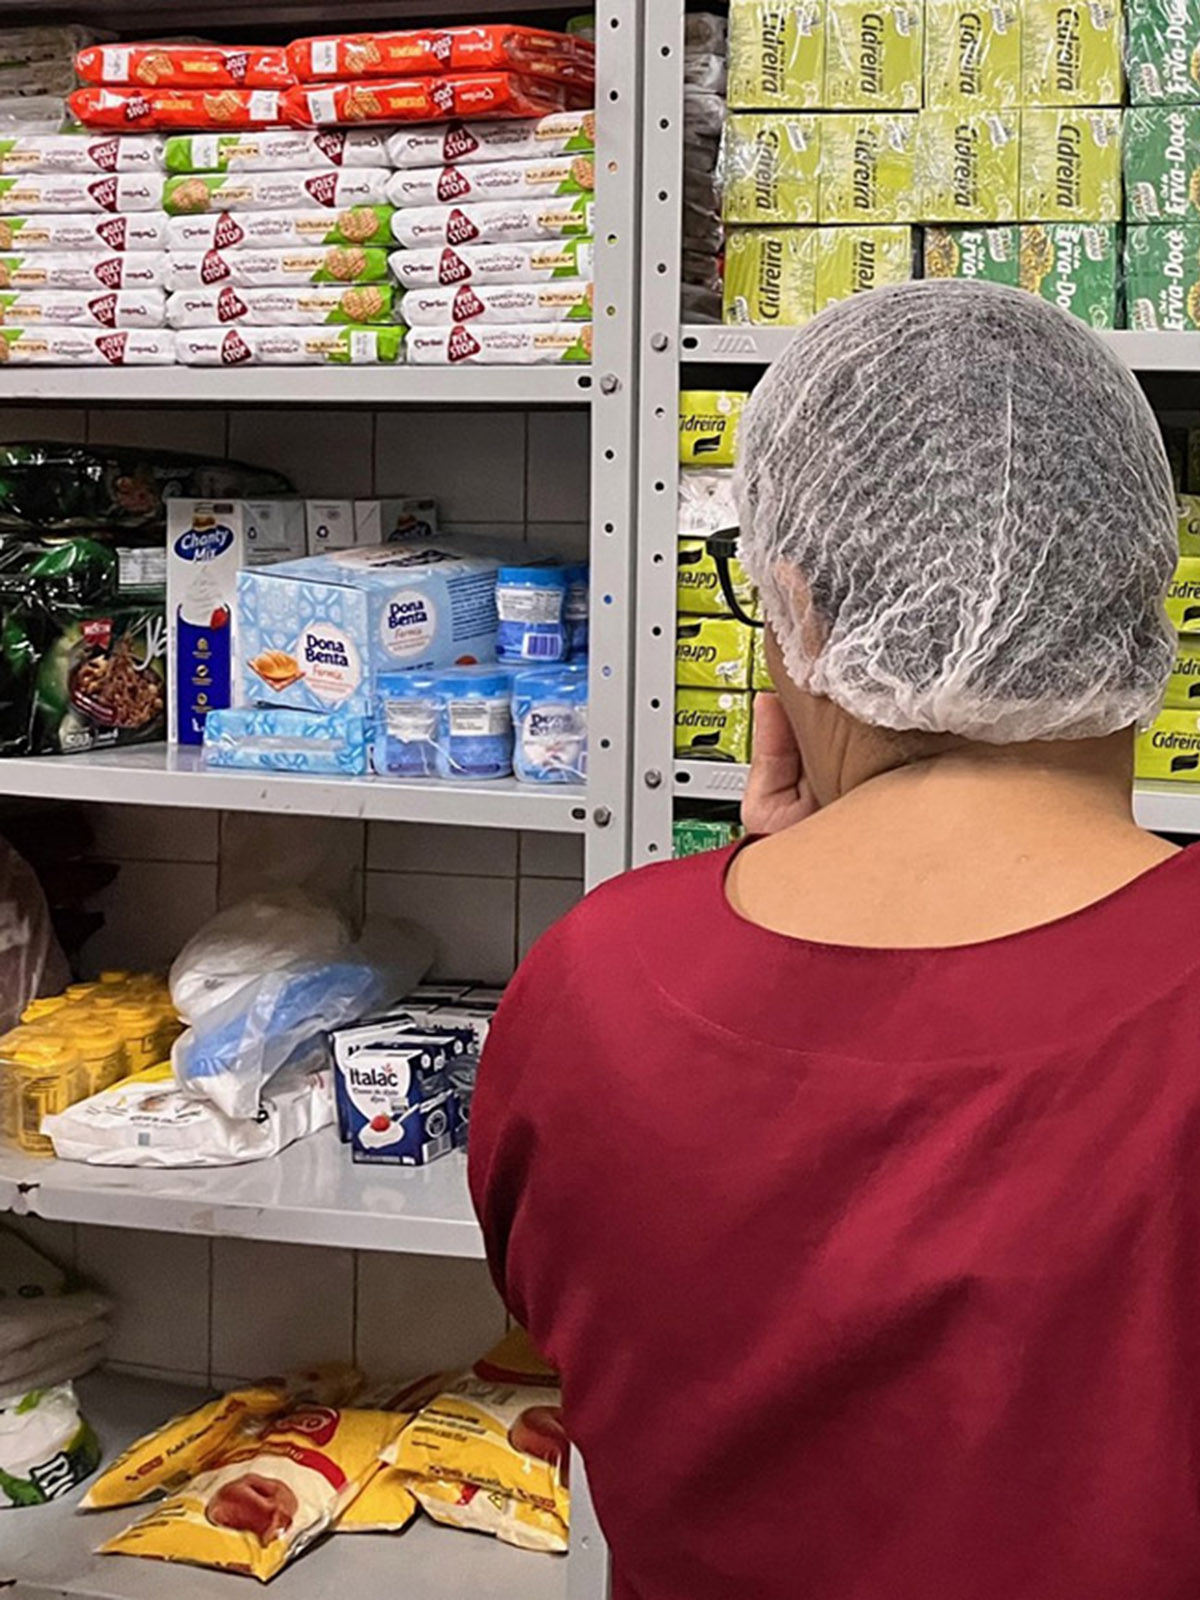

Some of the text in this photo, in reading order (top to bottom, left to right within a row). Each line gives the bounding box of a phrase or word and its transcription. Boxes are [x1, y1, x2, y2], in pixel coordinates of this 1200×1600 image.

[860, 13, 884, 94] Cidreira
[1057, 125, 1081, 208] Cidreira
[1166, 112, 1186, 214] Erva-Doce
[758, 240, 782, 319] Cidreira
[1163, 228, 1185, 330] Erva-Doce
[181, 529, 228, 550] Chanty
[194, 548, 216, 563] Mix
[390, 601, 424, 618] Dona
[388, 612, 428, 629] Benta
[306, 634, 345, 653] Dona
[304, 649, 349, 667] Benta
[351, 1068, 398, 1087] Italac
